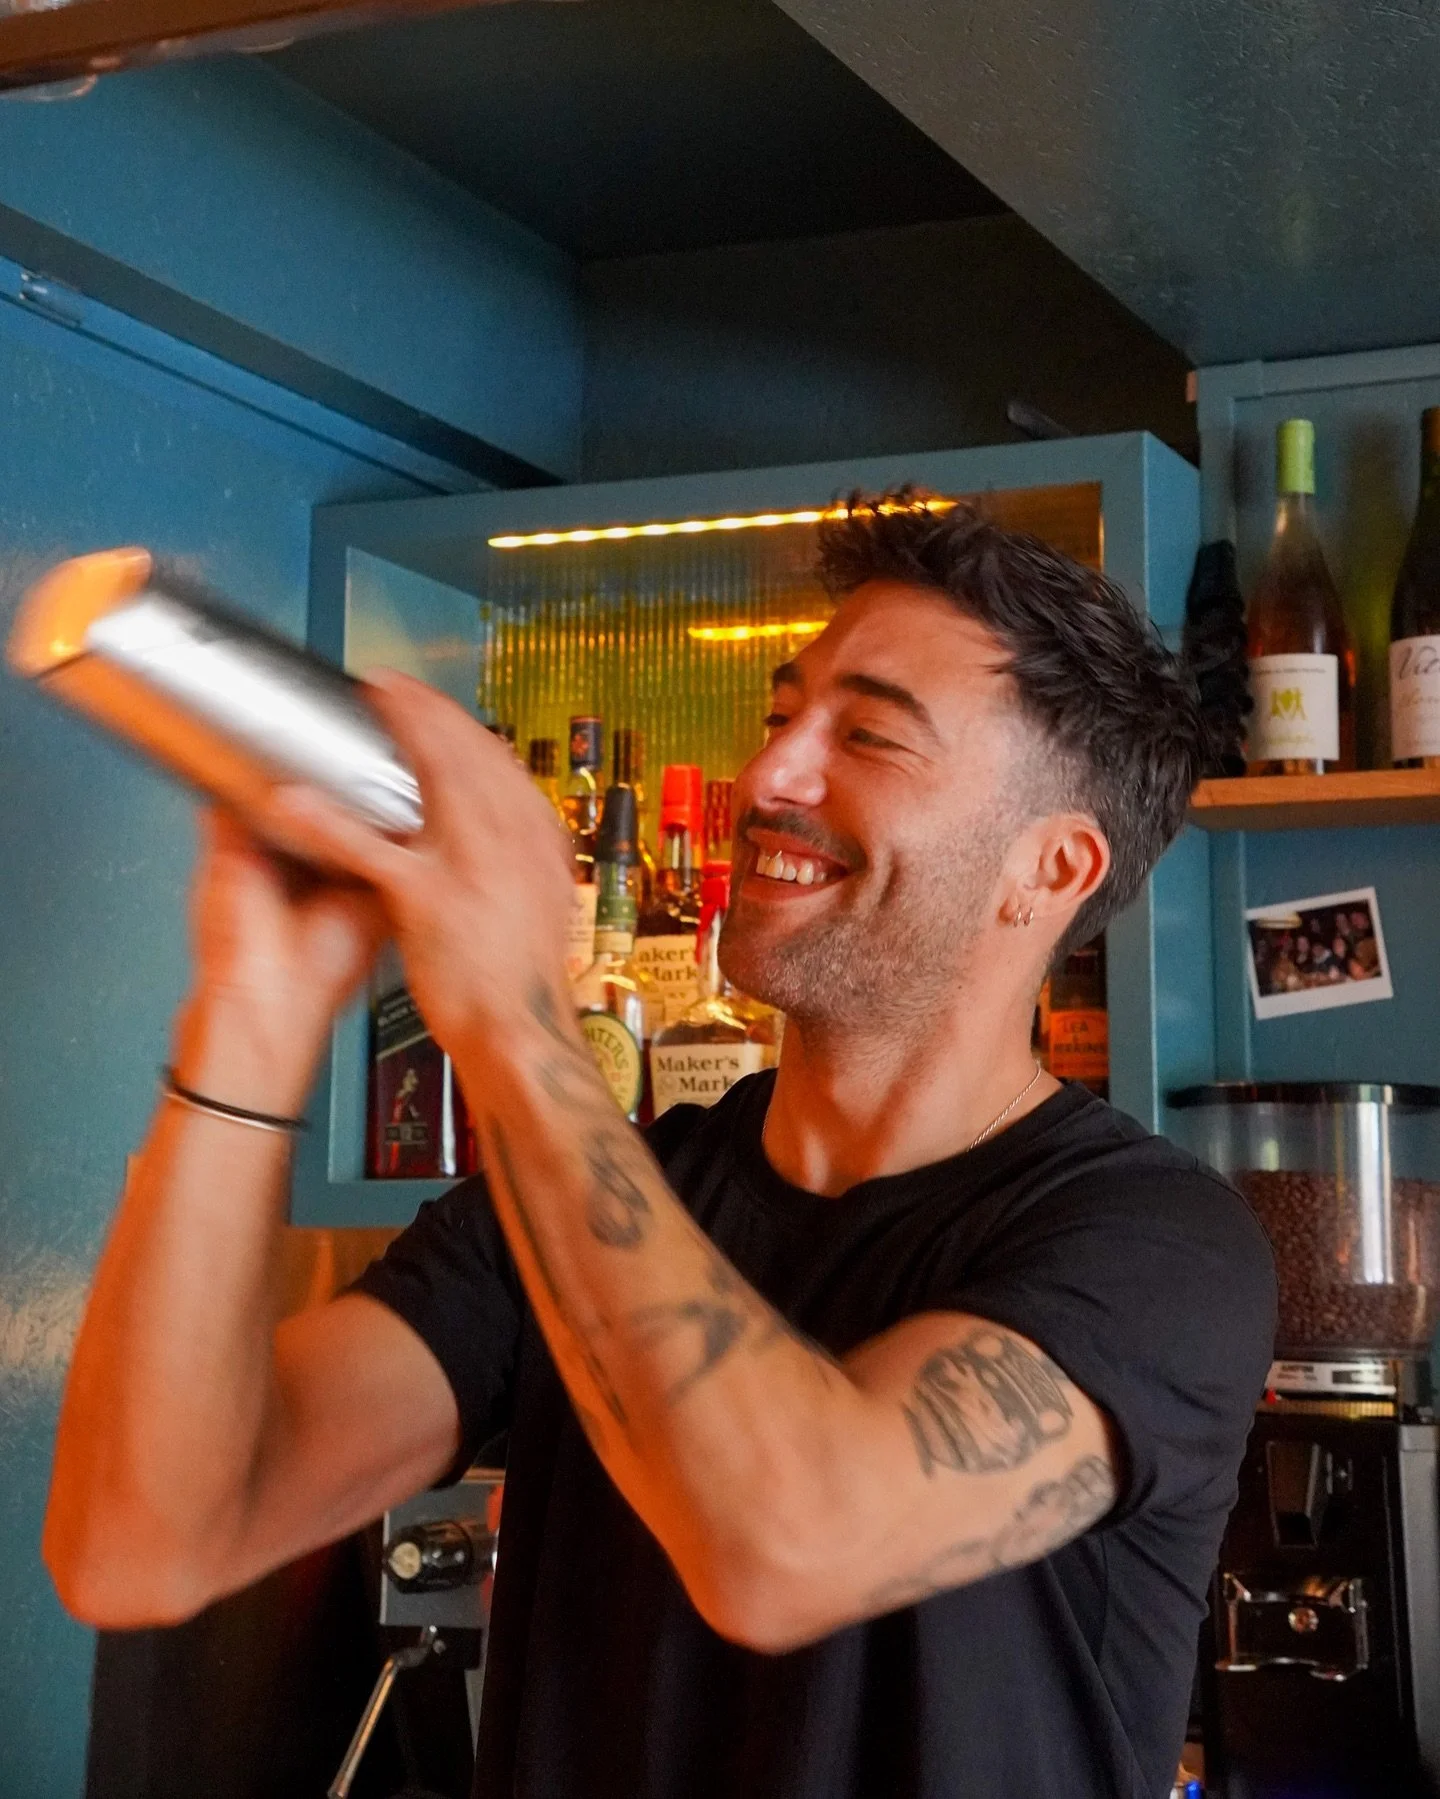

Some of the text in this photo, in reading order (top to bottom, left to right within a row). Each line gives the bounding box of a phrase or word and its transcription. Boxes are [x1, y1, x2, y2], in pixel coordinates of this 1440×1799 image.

[638, 947, 694, 962] aker'
[1064, 1022, 1089, 1033] LEA
[656, 1055, 740, 1073] Maker's
